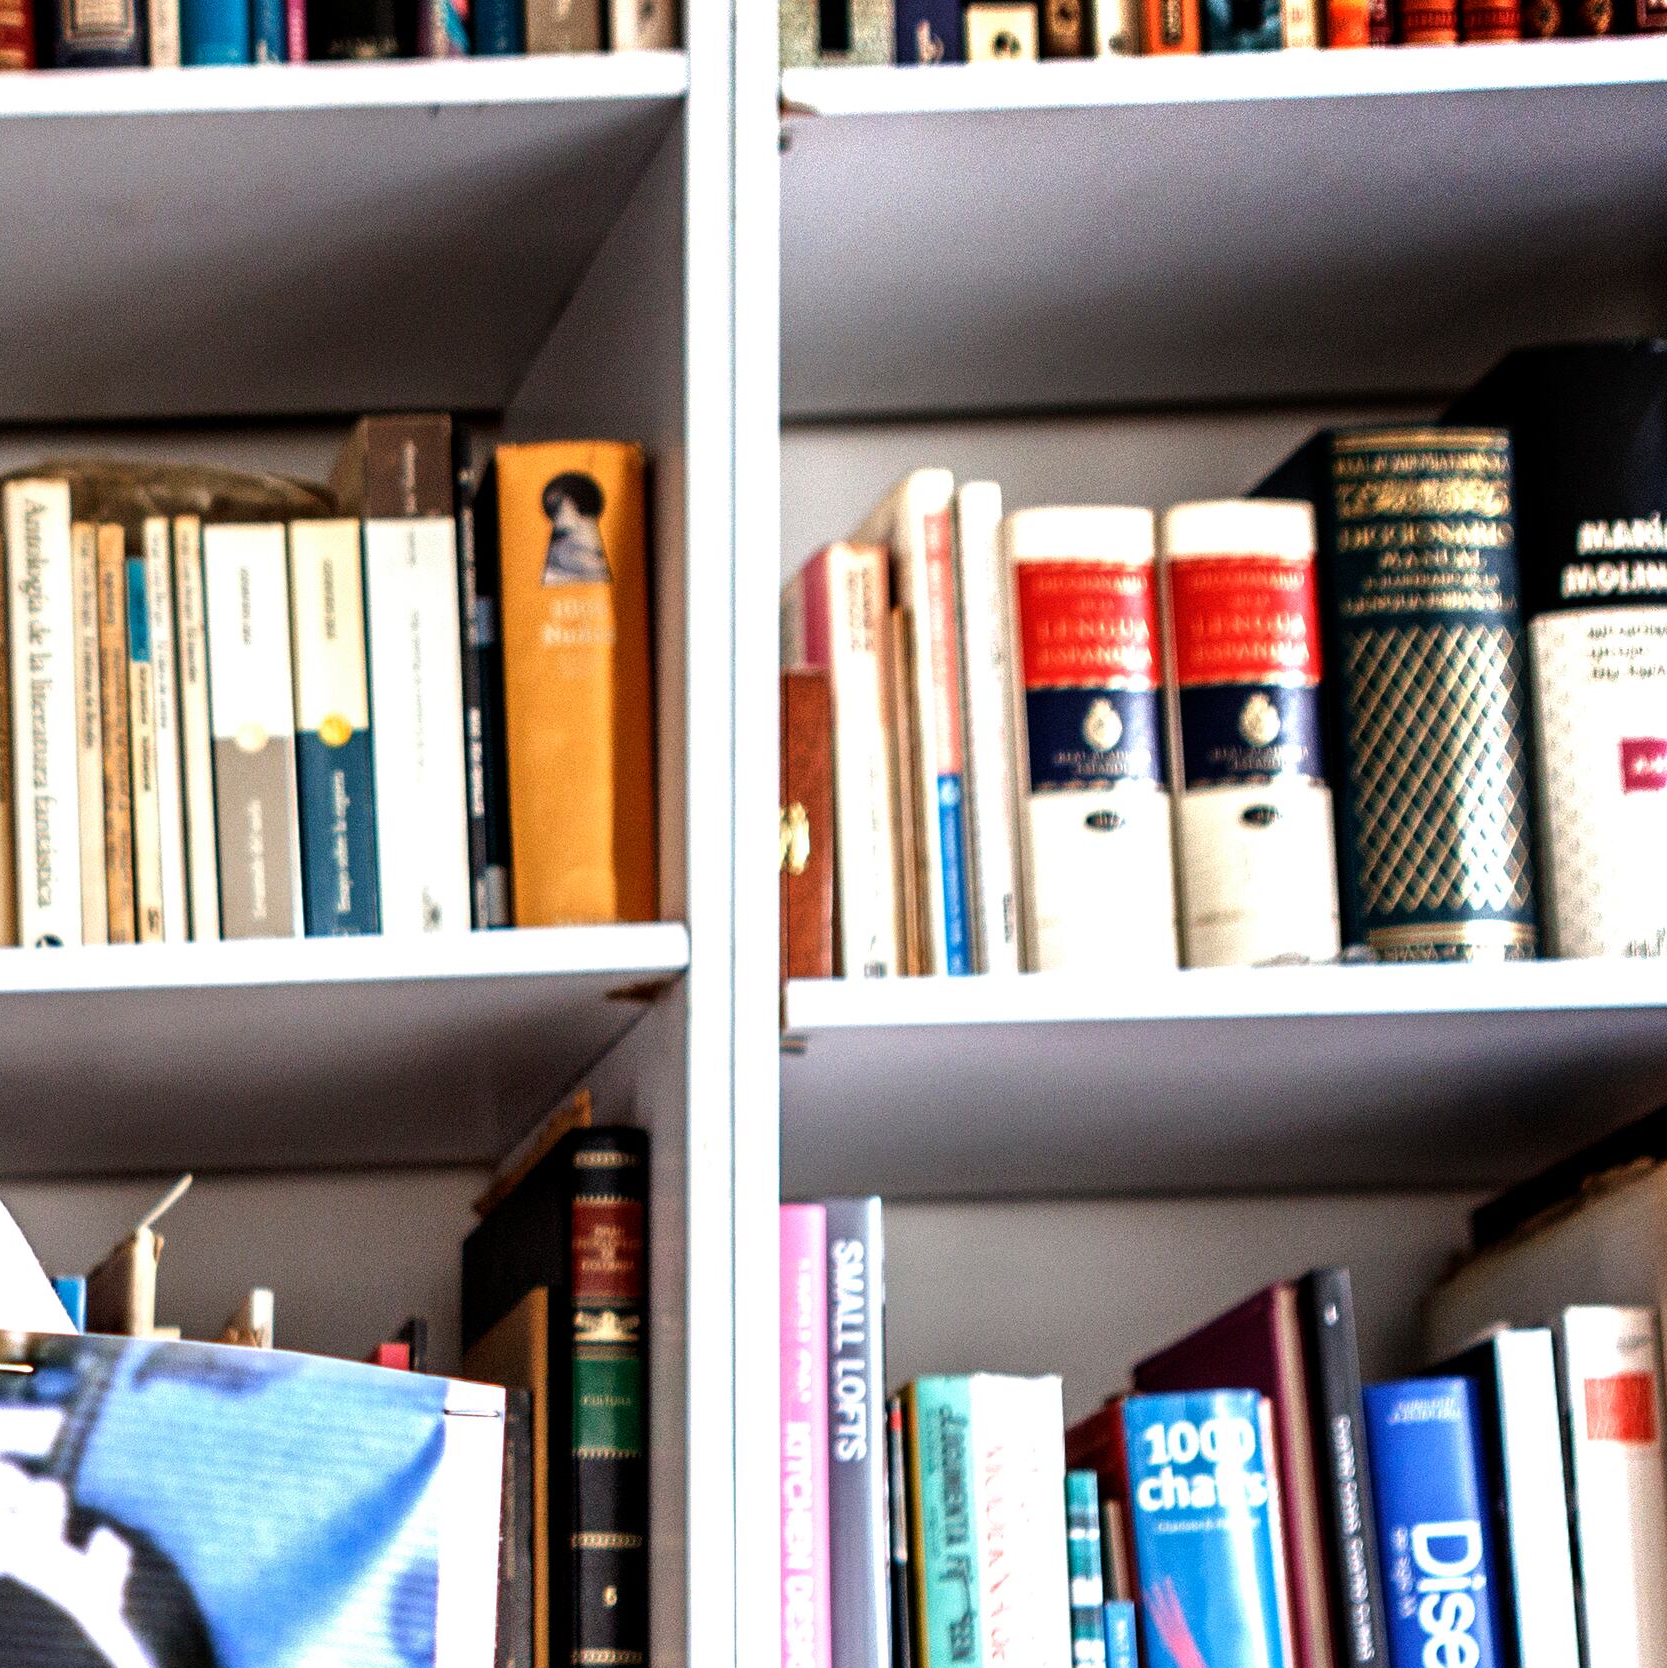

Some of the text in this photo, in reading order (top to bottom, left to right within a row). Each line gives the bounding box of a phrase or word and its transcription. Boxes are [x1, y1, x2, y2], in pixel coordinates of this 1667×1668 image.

[1576, 509, 1667, 557] MARÍ
[18, 500, 57, 908] Antología de la literatura fantástica
[831, 1238, 867, 1461] SMALL LOFTS
[785, 1420, 814, 1571] KITCHEN
[1142, 1416, 1258, 1467] 1000
